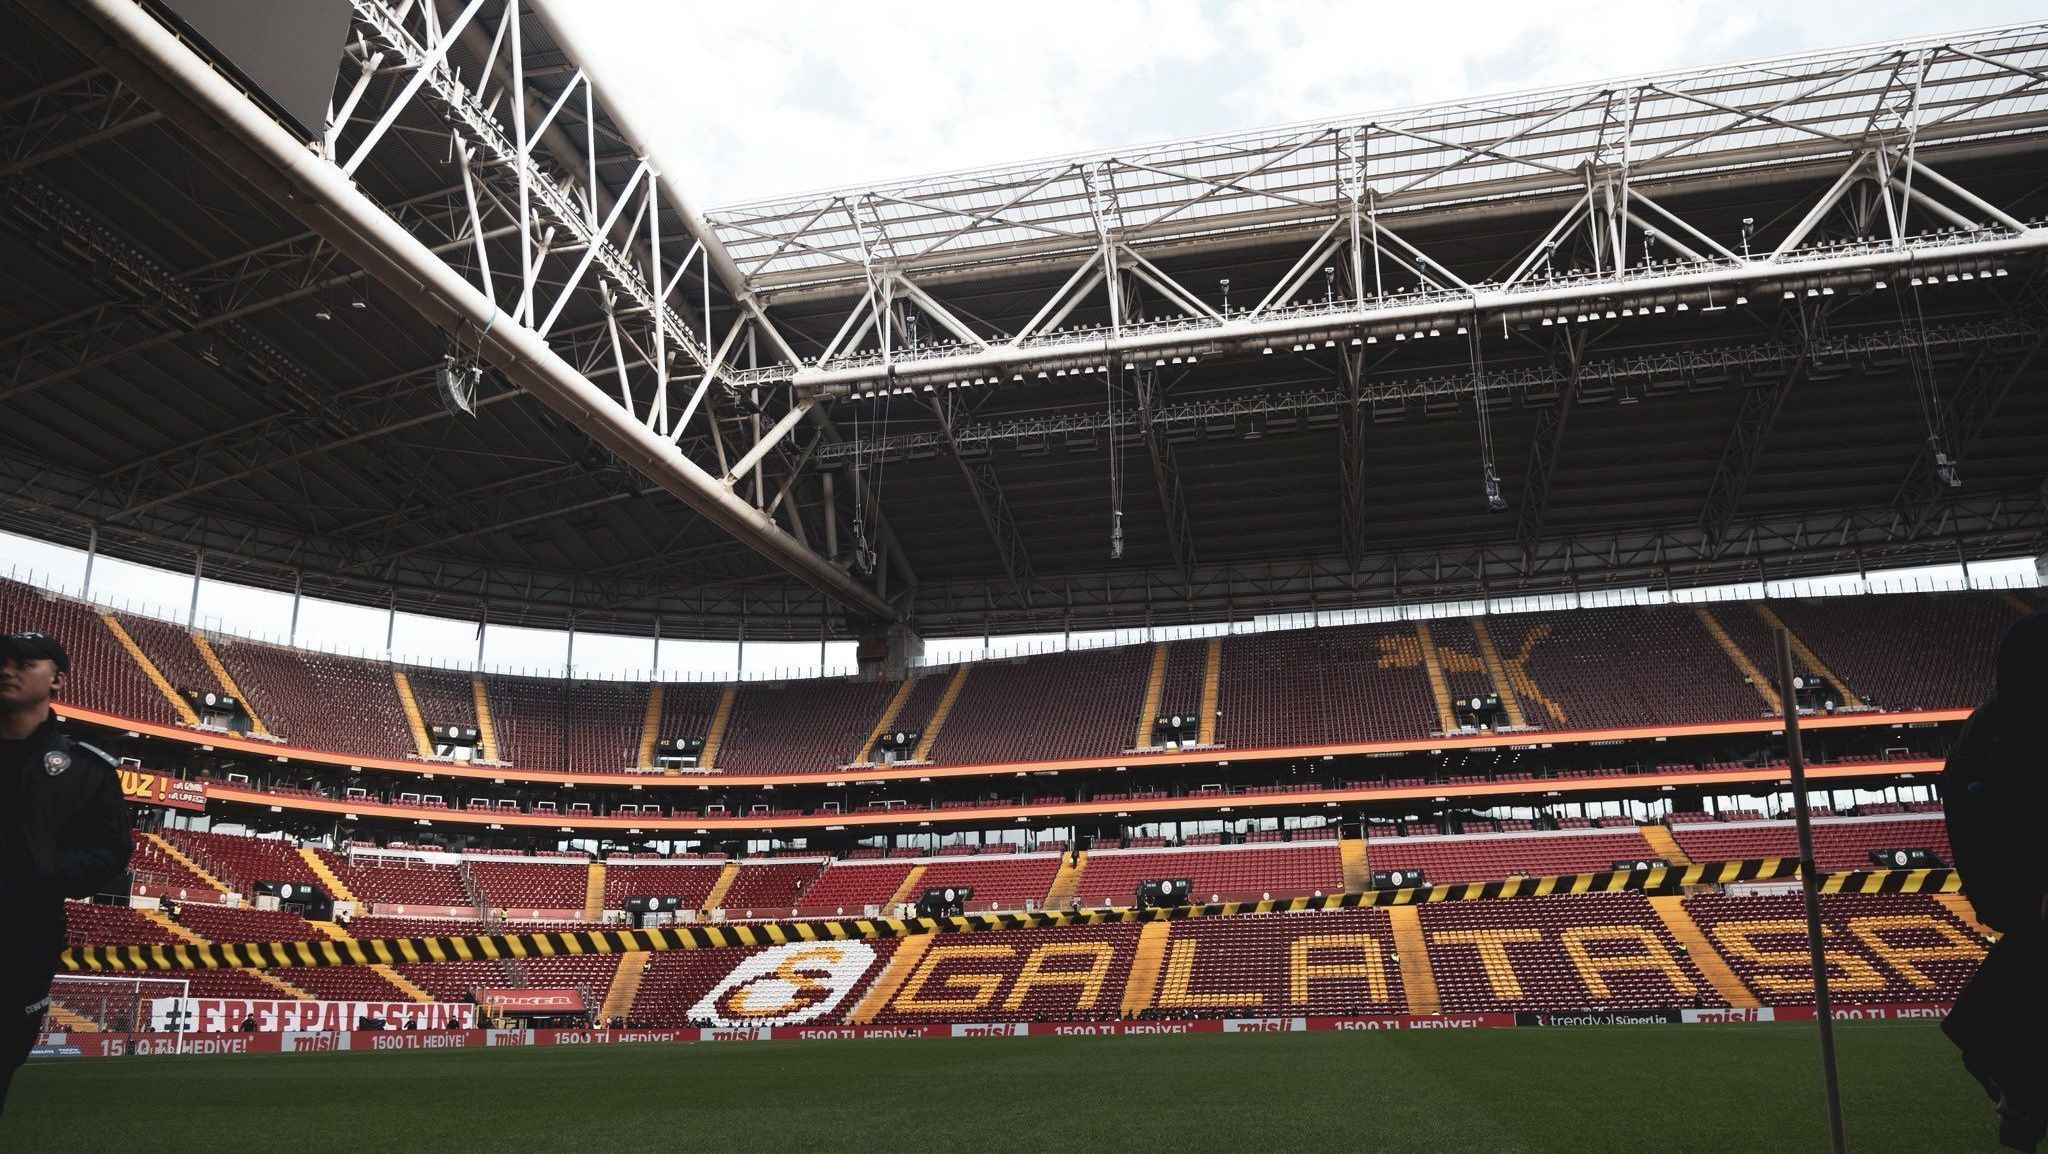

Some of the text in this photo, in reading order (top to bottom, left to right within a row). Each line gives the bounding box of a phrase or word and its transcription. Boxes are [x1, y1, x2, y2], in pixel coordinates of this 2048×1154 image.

[1697, 1009, 1758, 1022] misli
[965, 1024, 1016, 1036] misli
[1055, 1026, 1096, 1035] 1500
[1237, 1018, 1292, 1032] misli
[1335, 1021, 1379, 1030] 1500
[495, 1030, 528, 1046] misli
[554, 1032, 591, 1044] 1500
[712, 1027, 760, 1040] misli
[800, 1030, 838, 1039] 1500
[294, 1031, 341, 1052] misli
[371, 1035, 403, 1050] 1500
[406, 1035, 420, 1049] TL
